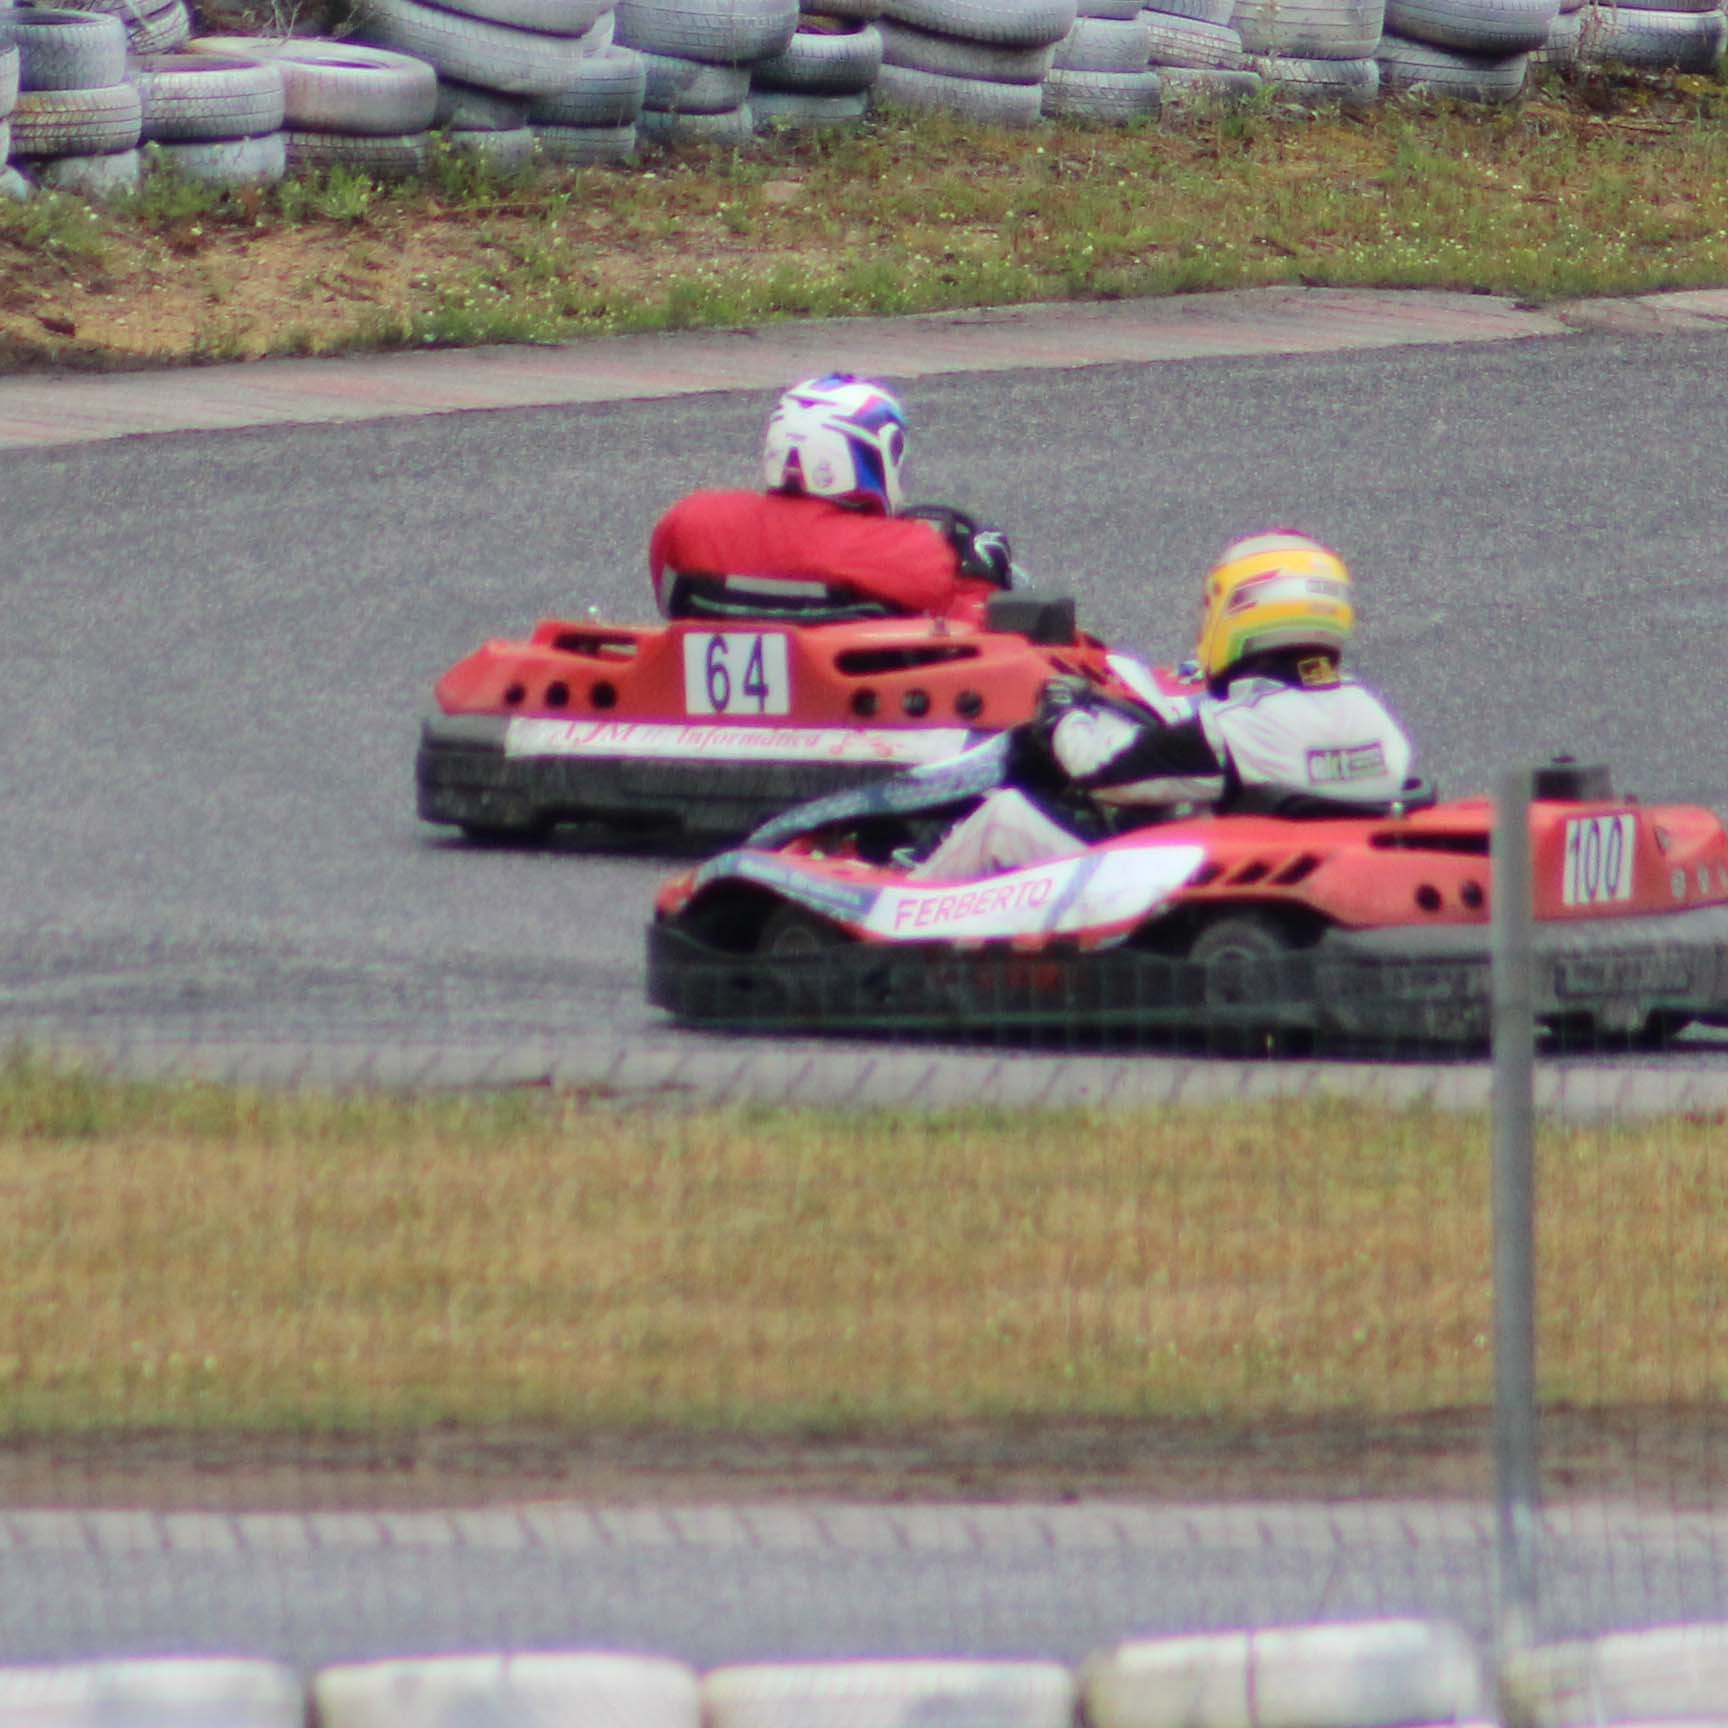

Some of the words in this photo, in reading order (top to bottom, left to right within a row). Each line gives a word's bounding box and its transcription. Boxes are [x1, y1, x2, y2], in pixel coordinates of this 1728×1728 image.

[704, 632, 770, 714] 64
[1568, 816, 1623, 903] 100
[894, 876, 1053, 931] FERBERTO
